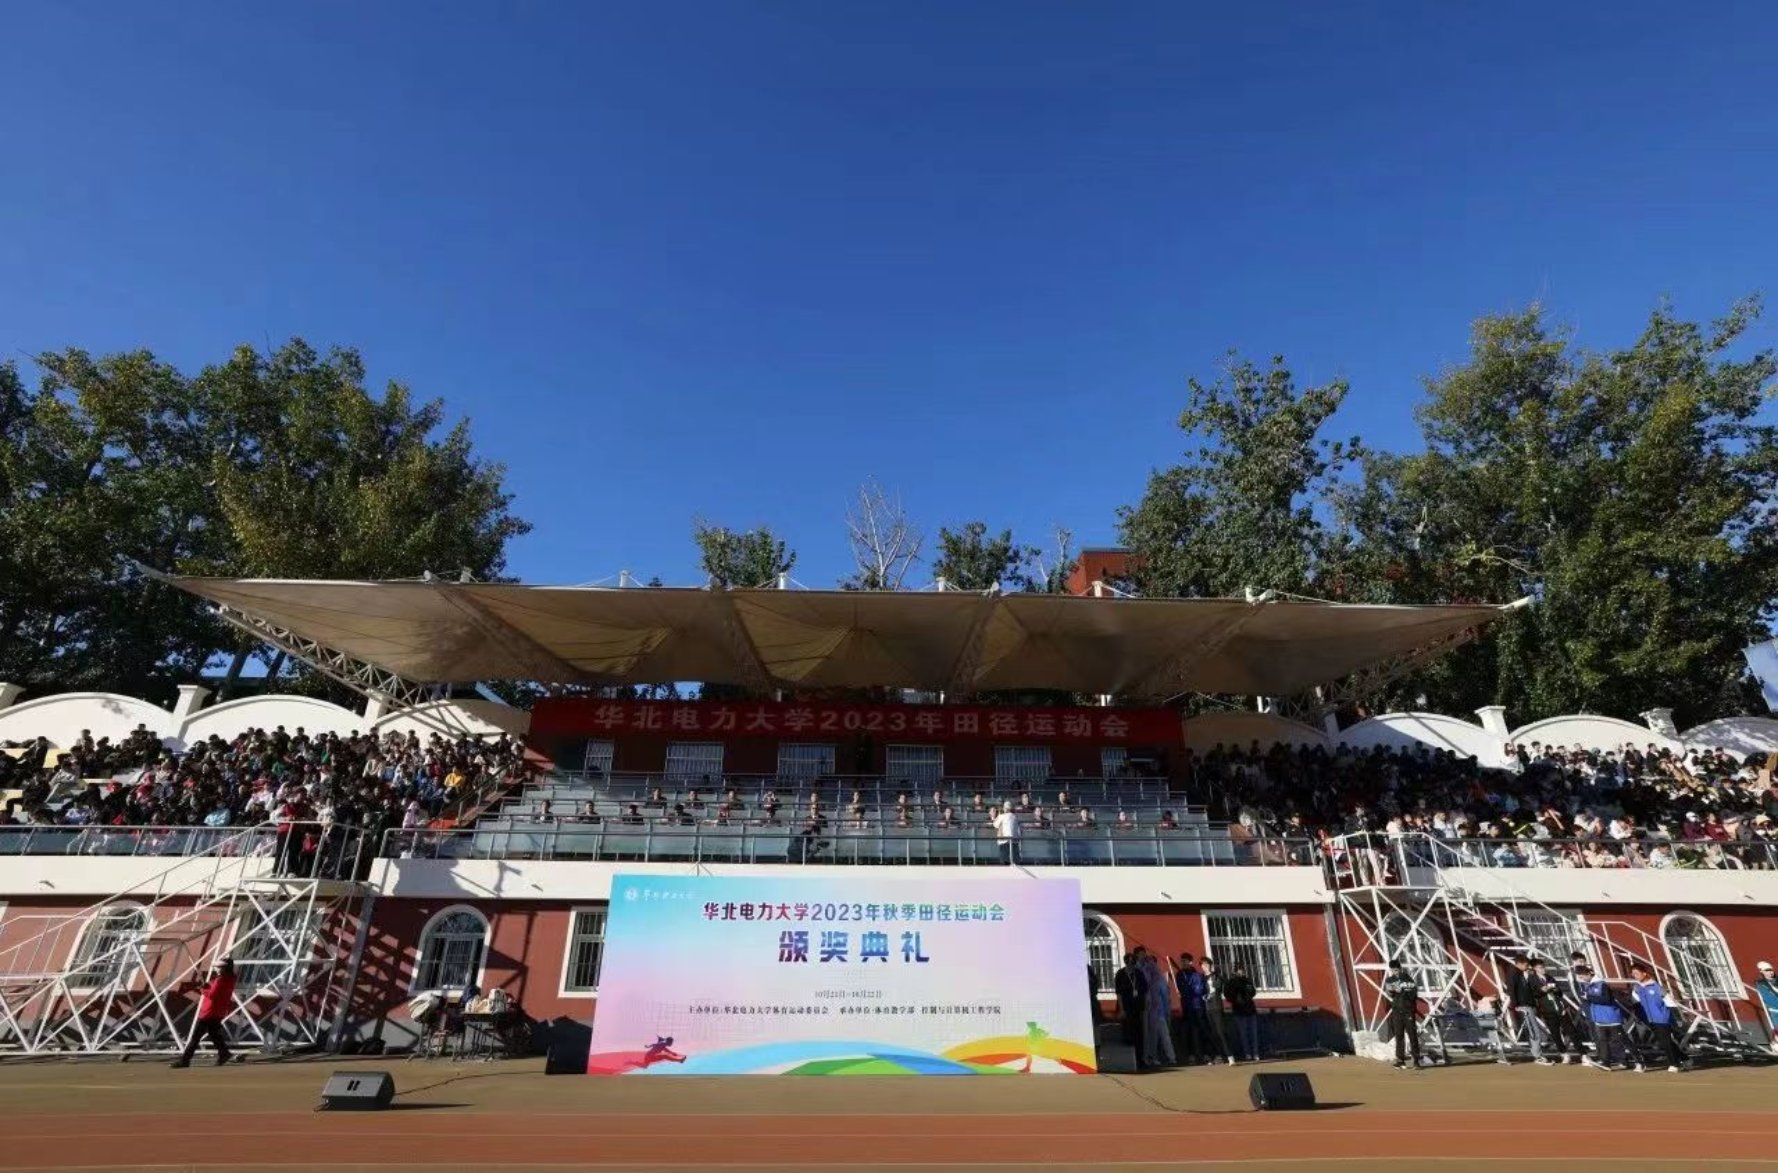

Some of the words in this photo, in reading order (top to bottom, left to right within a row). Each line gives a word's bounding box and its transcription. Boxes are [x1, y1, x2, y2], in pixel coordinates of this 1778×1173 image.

[594, 705, 1129, 737] 华北电力大学2023年田径运动会
[703, 902, 1005, 922] 华北电力大学2023年秋季田径运动会
[778, 930, 930, 963] 颁奖典礼
